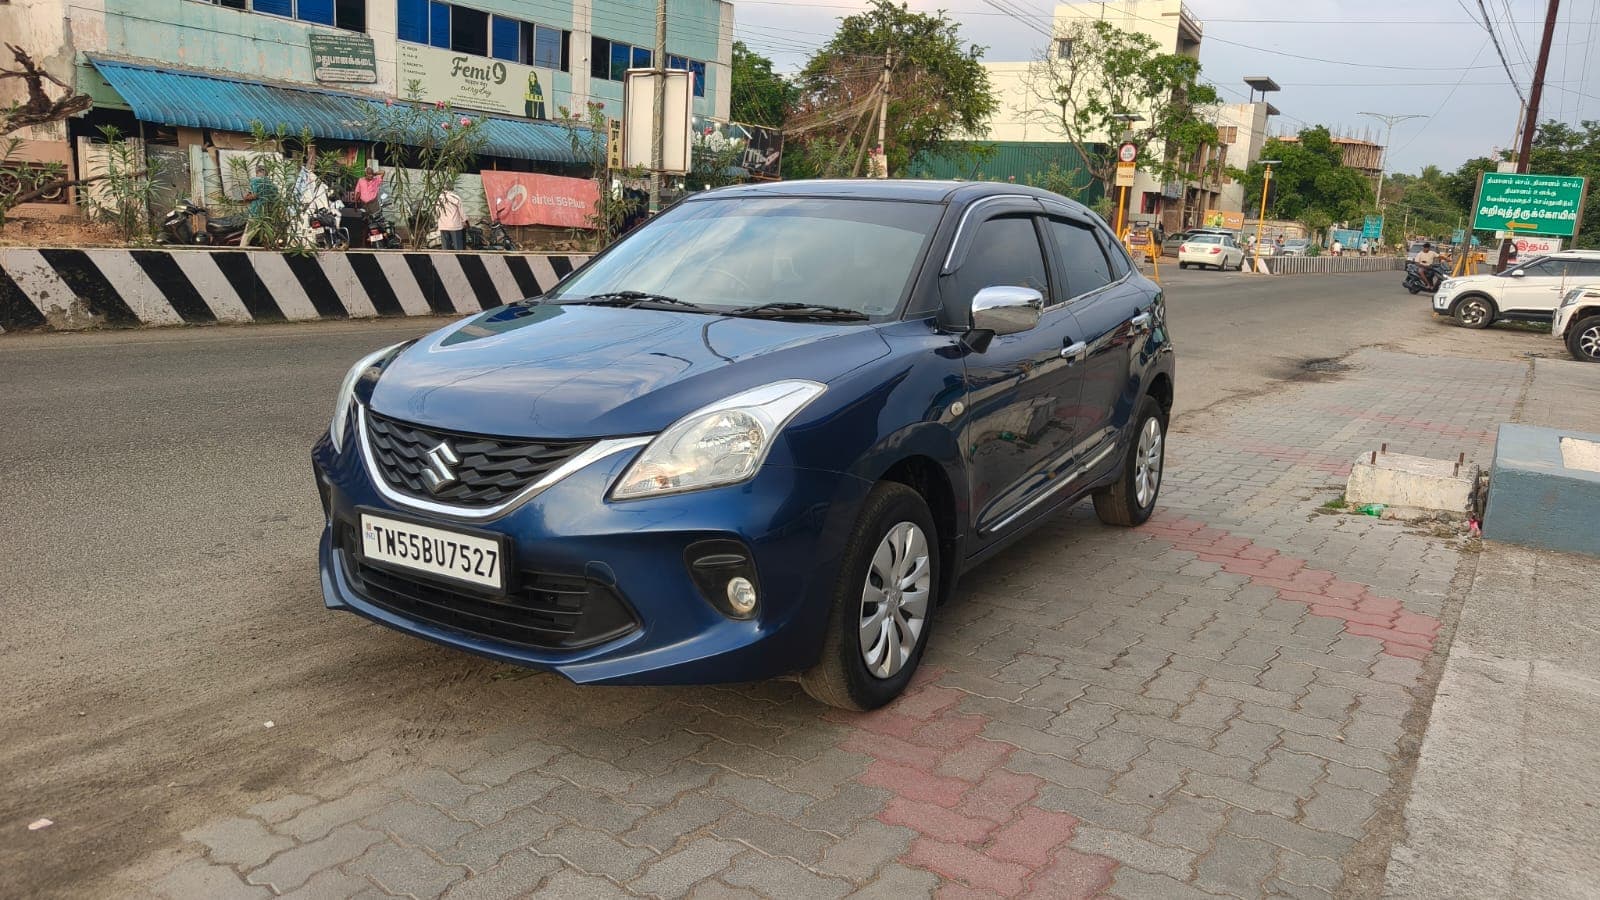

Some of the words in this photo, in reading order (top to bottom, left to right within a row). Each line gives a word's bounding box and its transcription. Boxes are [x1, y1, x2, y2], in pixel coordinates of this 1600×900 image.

[531, 194, 554, 206] airtel
[1479, 205, 1577, 220] அறிவுத்திருக்கோயில்
[1516, 239, 1550, 252] இதம்
[373, 525, 497, 578] TN55BU7527
